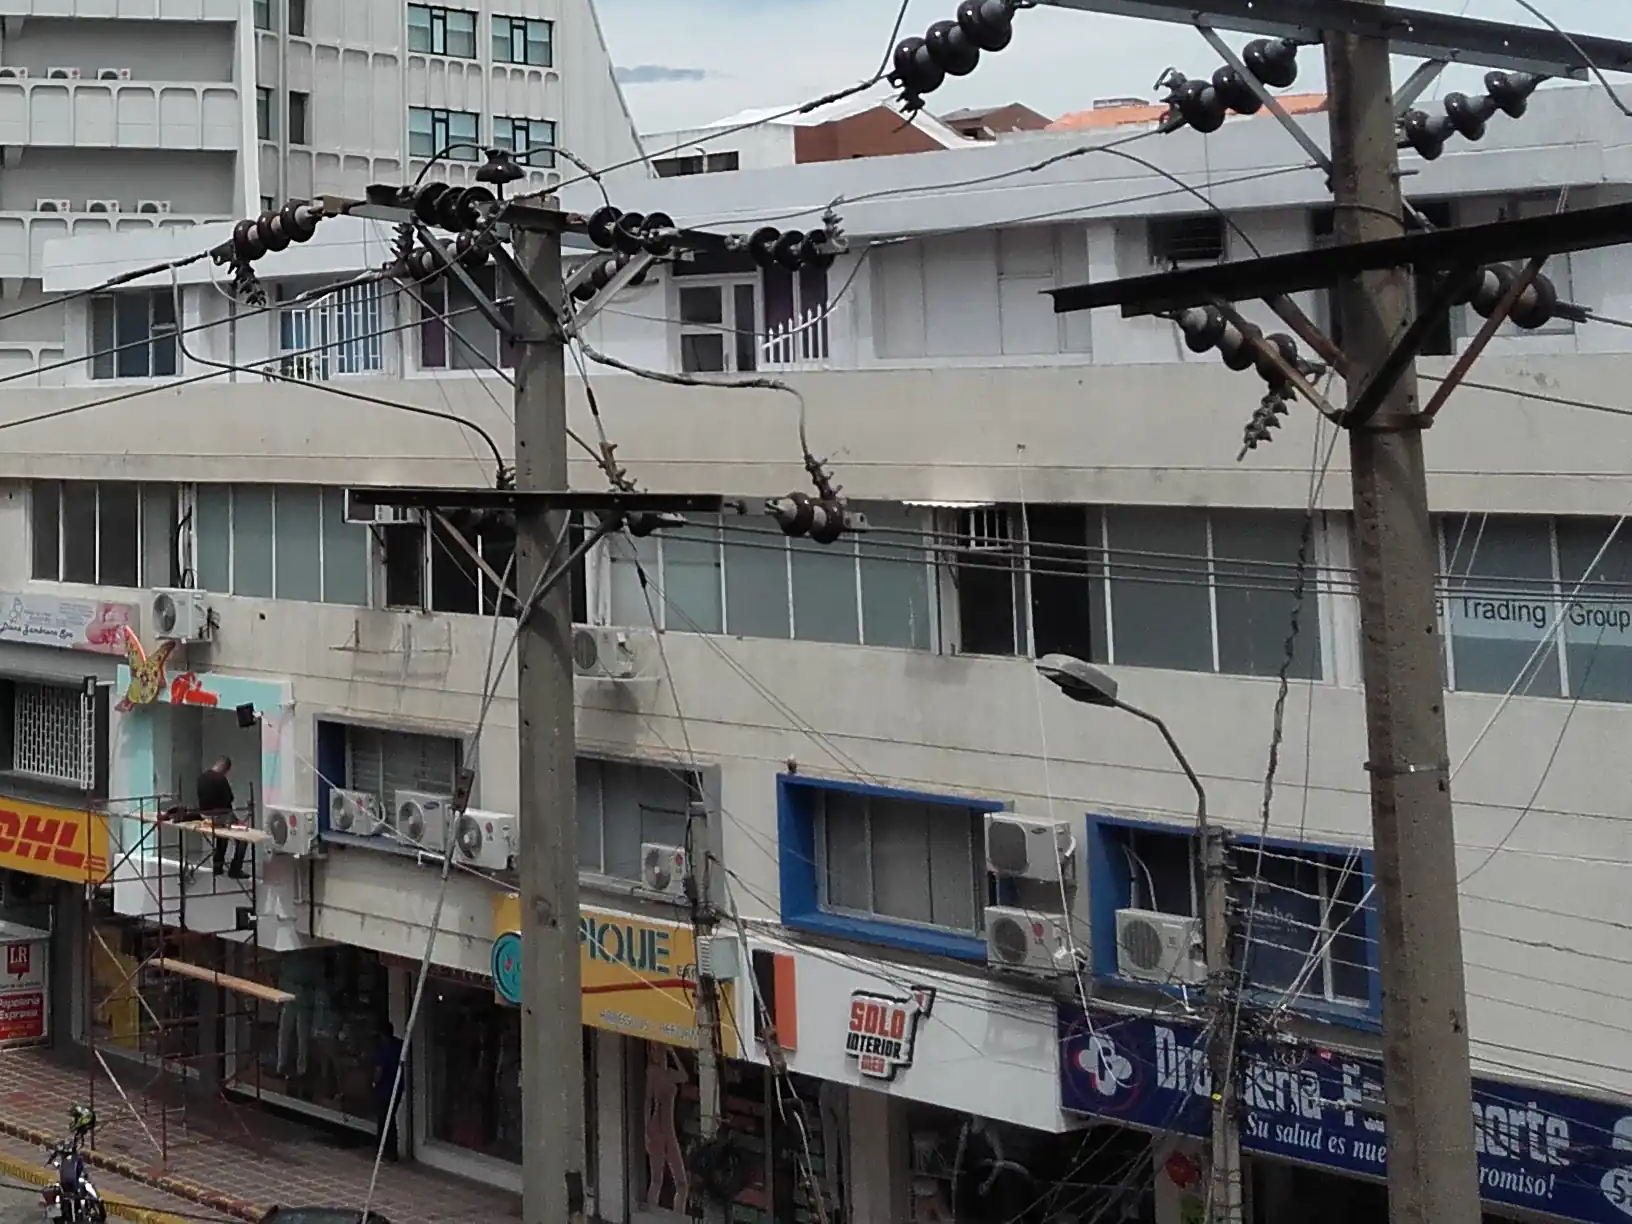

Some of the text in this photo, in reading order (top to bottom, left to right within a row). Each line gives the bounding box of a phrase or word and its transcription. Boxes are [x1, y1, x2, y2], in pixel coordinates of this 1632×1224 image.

[1462, 596, 1547, 629] Trading
[1569, 603, 1631, 634] Group
[9, 946, 28, 964] LR
[849, 1001, 906, 1040] SOLO
[846, 1032, 902, 1060] INTERIOR
[1246, 1111, 1269, 1139] Su
[1275, 1122, 1322, 1150] salud
[1328, 1136, 1346, 1155] es
